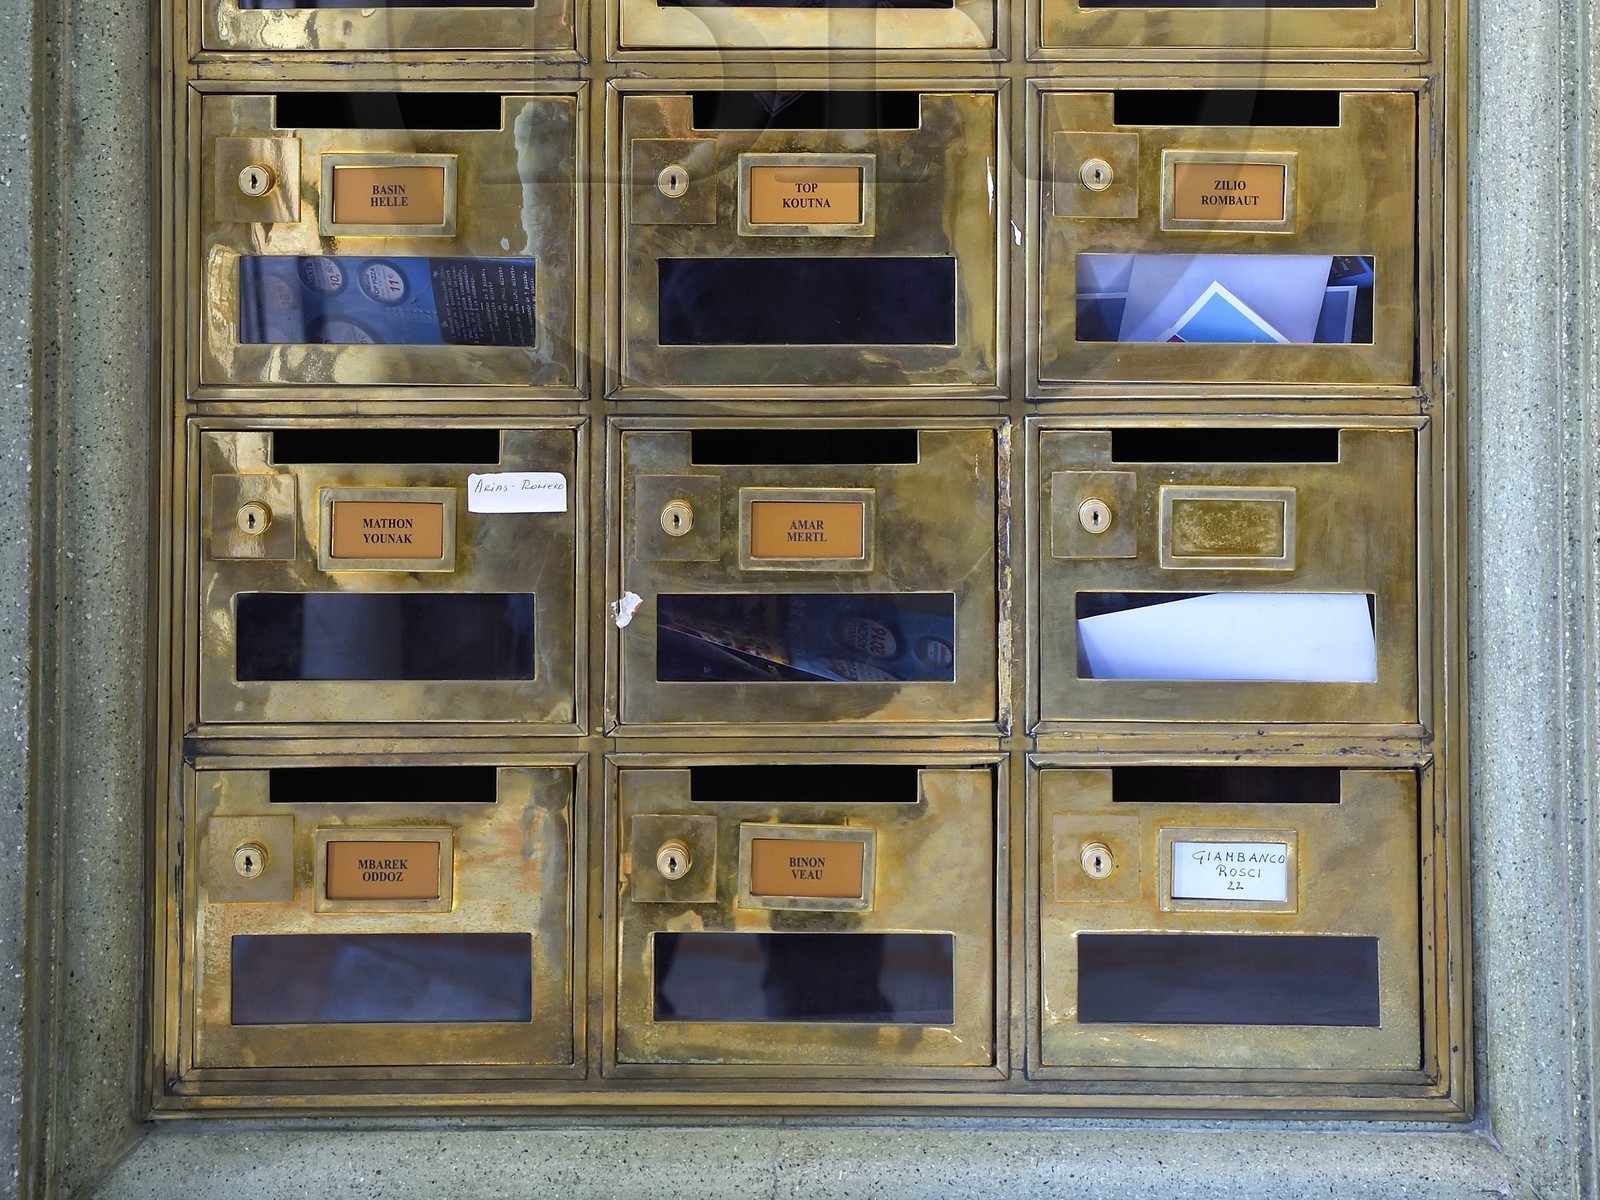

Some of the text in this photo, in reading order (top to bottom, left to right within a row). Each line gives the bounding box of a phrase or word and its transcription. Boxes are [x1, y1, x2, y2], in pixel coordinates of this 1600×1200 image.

[372, 184, 406, 195] BASIN
[795, 183, 818, 193] TOP
[1213, 180, 1247, 191] ZILIO
[370, 196, 409, 207] HELLE
[782, 197, 832, 208] KOUTNA
[1200, 195, 1260, 206] ROMBAUT
[362, 518, 414, 529] MATHON
[789, 519, 825, 530] AMAR
[362, 533, 413, 544] YOUNAK
[786, 531, 828, 542] MERTL
[789, 857, 826, 867] BINON
[1191, 850, 1285, 864] GIAMBANCO
[358, 859, 409, 870] MBAREK
[791, 870, 824, 880] VEAU
[1216, 864, 1261, 877] ROSCI
[362, 871, 404, 882] ODDOZ
[1227, 881, 1244, 891] 22
